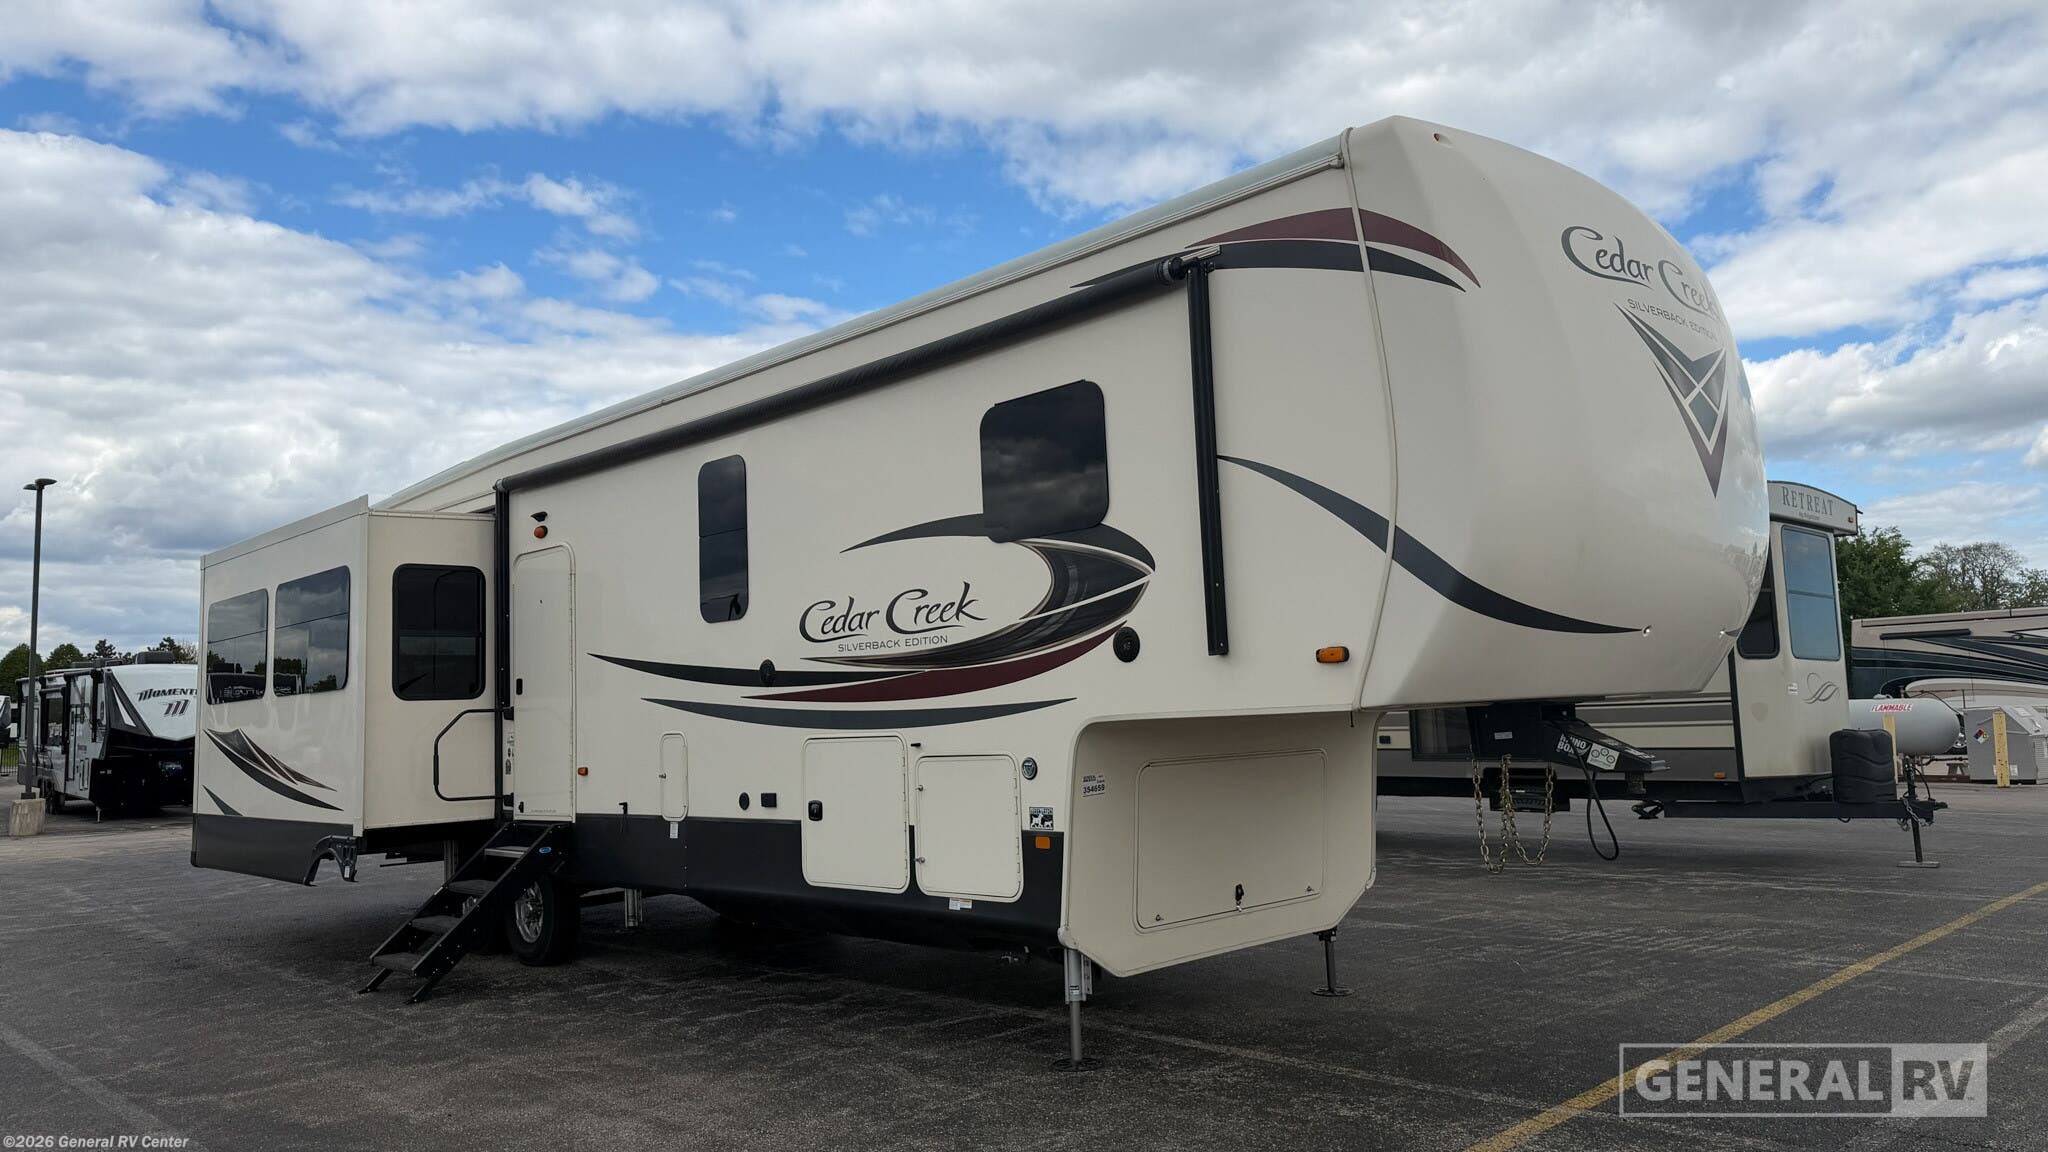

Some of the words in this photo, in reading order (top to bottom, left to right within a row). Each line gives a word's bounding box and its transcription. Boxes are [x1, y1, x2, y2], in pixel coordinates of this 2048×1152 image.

[1561, 226, 1654, 289] Cedar
[1627, 298, 1688, 326] SILVERBACK
[1782, 486, 1834, 516] RETREAT
[799, 596, 880, 643] Cedar
[886, 581, 988, 635] Creek
[837, 639, 900, 652] SILVERBACK
[905, 635, 948, 647] EDITION
[1871, 703, 1912, 711] FLAMMABLE
